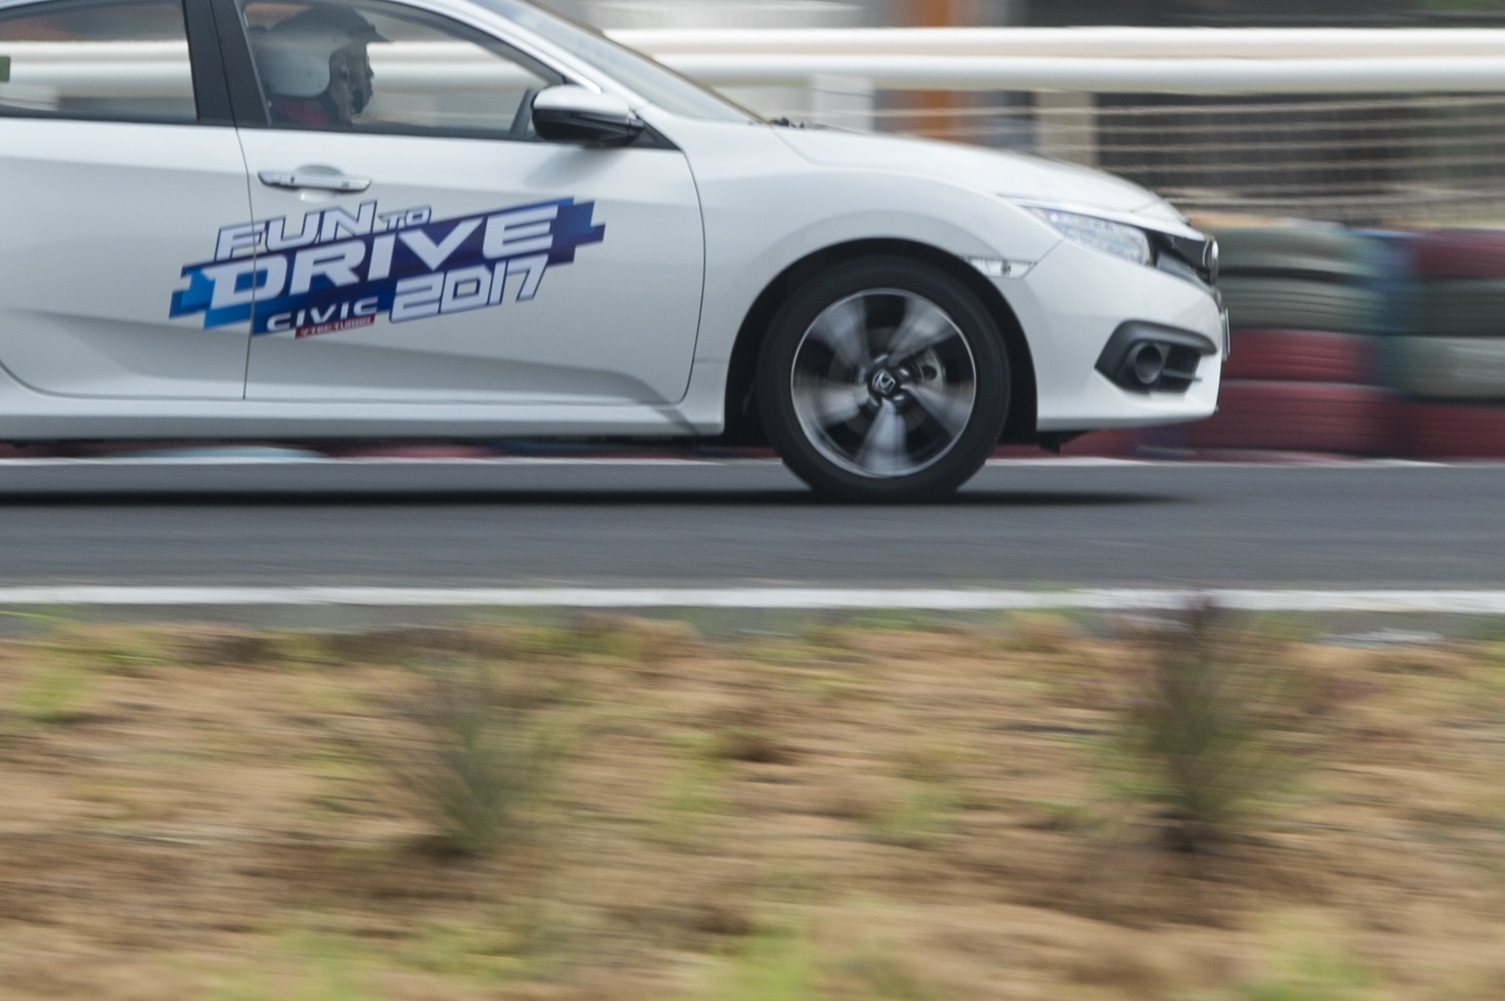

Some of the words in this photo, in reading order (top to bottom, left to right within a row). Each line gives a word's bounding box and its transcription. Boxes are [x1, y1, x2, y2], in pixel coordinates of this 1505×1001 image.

[199, 205, 559, 310] DRIVE
[215, 201, 377, 261] FUN
[378, 204, 432, 232] TO
[267, 296, 379, 332] CIVIC
[390, 255, 550, 323] 2017
